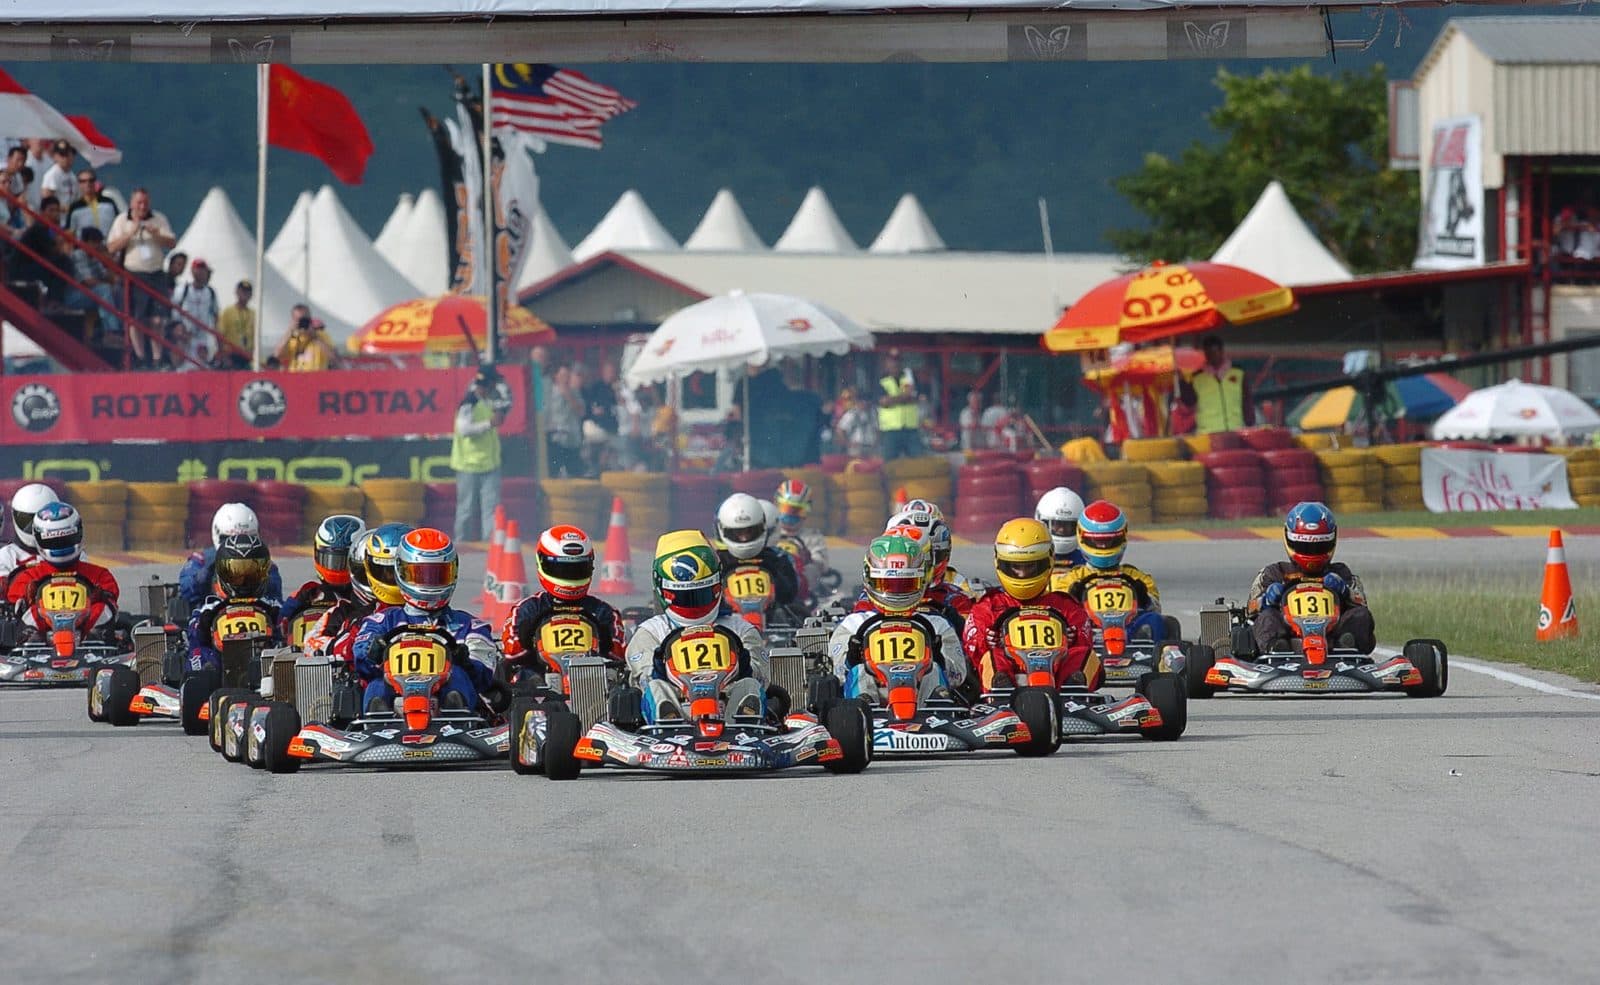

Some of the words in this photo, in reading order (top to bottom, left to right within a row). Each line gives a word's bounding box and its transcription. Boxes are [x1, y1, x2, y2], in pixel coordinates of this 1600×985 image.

[91, 393, 212, 418] ROTAX
[318, 388, 438, 416] ROTAX
[890, 561, 905, 569] TKP
[735, 577, 765, 595] 119
[49, 590, 80, 609] 117
[1095, 591, 1126, 610] 137
[1294, 596, 1331, 615] 131
[553, 628, 585, 648] 122
[1017, 624, 1055, 646] 118
[680, 643, 723, 670] 121
[877, 637, 916, 660] 112
[395, 652, 435, 674] 101
